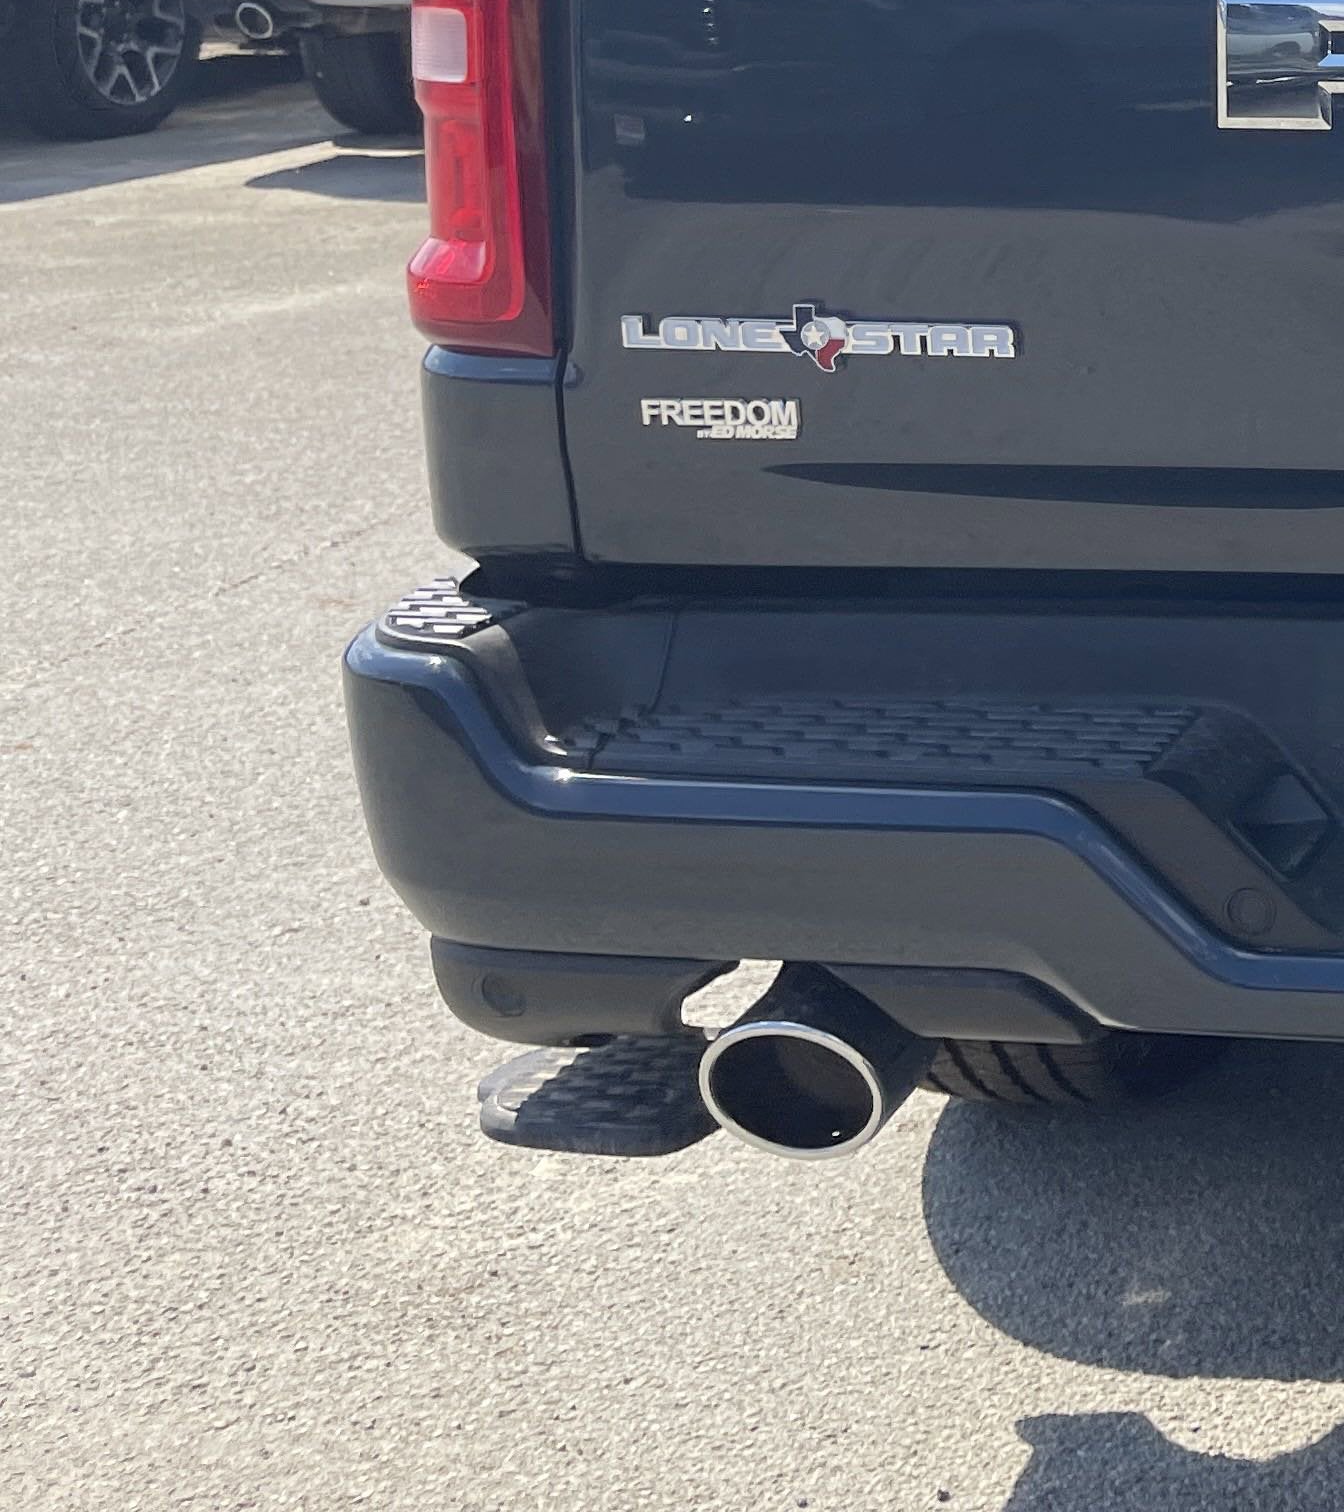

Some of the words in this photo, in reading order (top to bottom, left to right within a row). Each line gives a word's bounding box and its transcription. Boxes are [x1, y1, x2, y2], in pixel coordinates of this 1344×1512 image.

[621, 315, 787, 351] LONE
[846, 320, 1016, 358] STAR
[640, 399, 798, 426] FREEDOM
[711, 425, 735, 439] ED
[735, 425, 798, 439] MORSE
